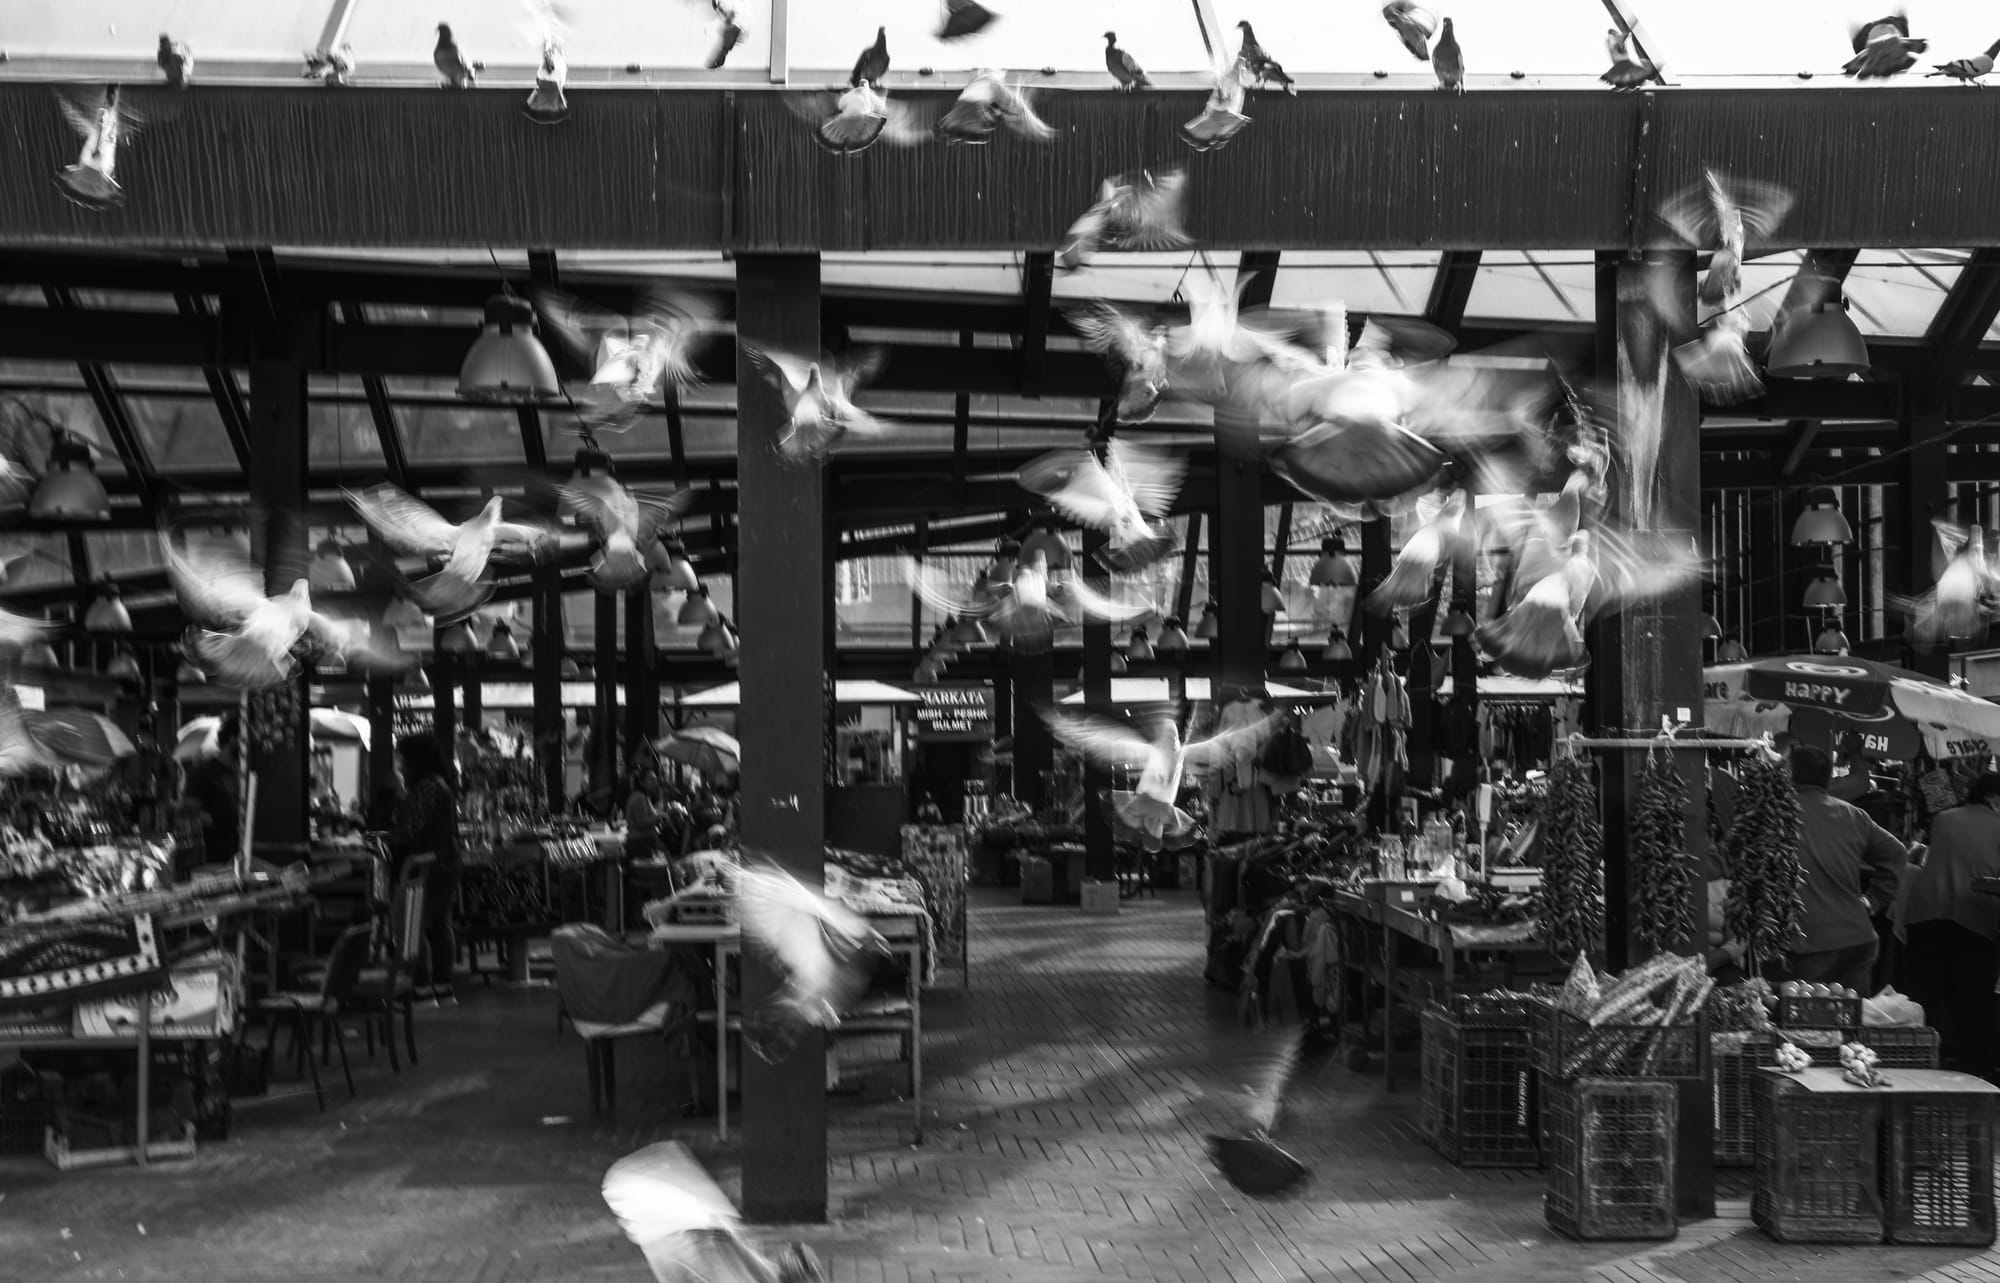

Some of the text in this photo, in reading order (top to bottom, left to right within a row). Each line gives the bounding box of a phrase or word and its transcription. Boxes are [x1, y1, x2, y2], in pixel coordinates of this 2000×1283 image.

[920, 690, 985, 706] MARKATA
[917, 708, 943, 720] MISH
[953, 708, 988, 720] PESHK
